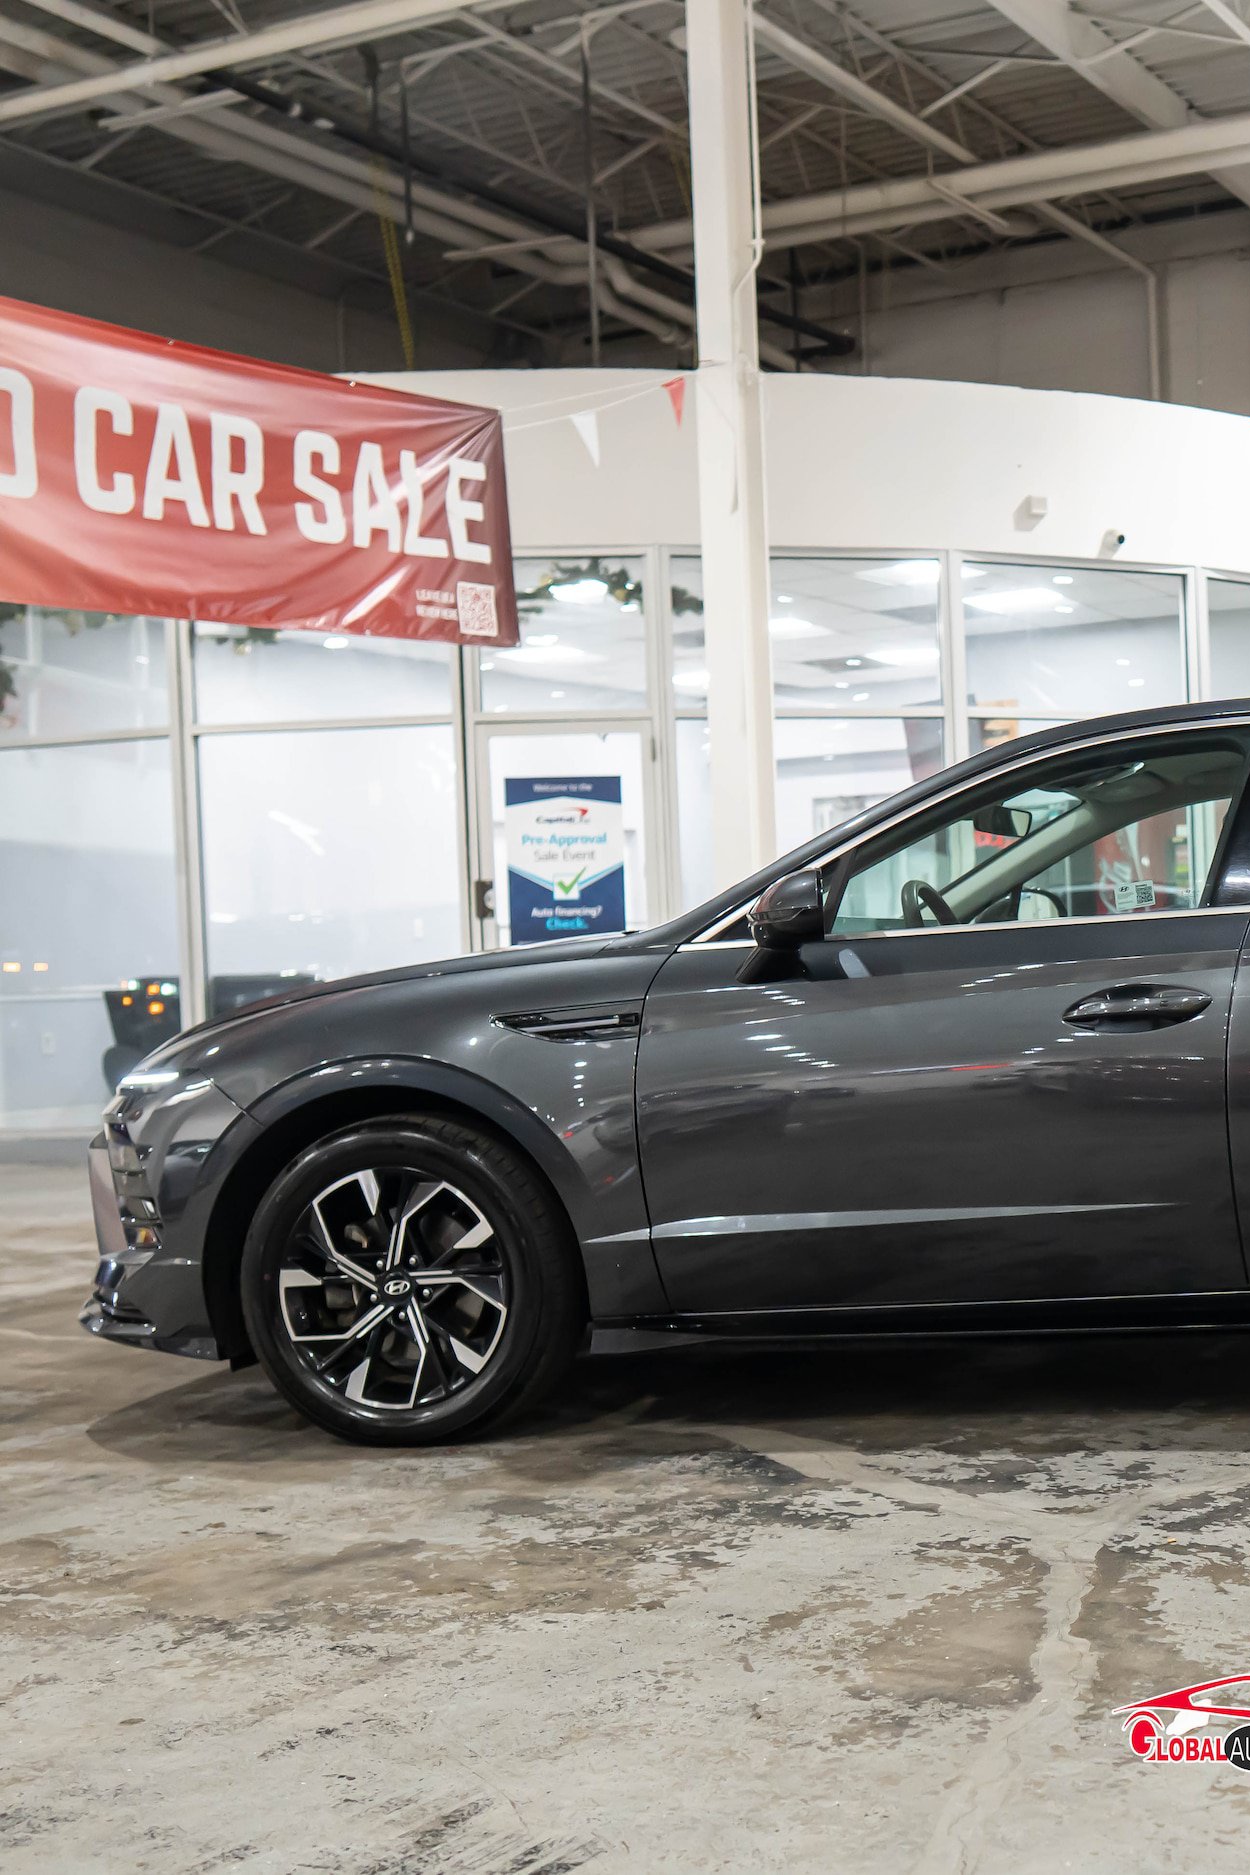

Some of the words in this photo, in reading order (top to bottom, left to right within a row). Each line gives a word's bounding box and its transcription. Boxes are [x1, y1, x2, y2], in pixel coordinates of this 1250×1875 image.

[73, 386, 267, 536] CAR
[293, 430, 491, 565] SALE
[522, 832, 607, 847] Pre-Approval
[534, 848, 559, 861] Sale
[563, 848, 595, 861] Event
[532, 906, 553, 917] Auto
[555, 905, 603, 918] financing?
